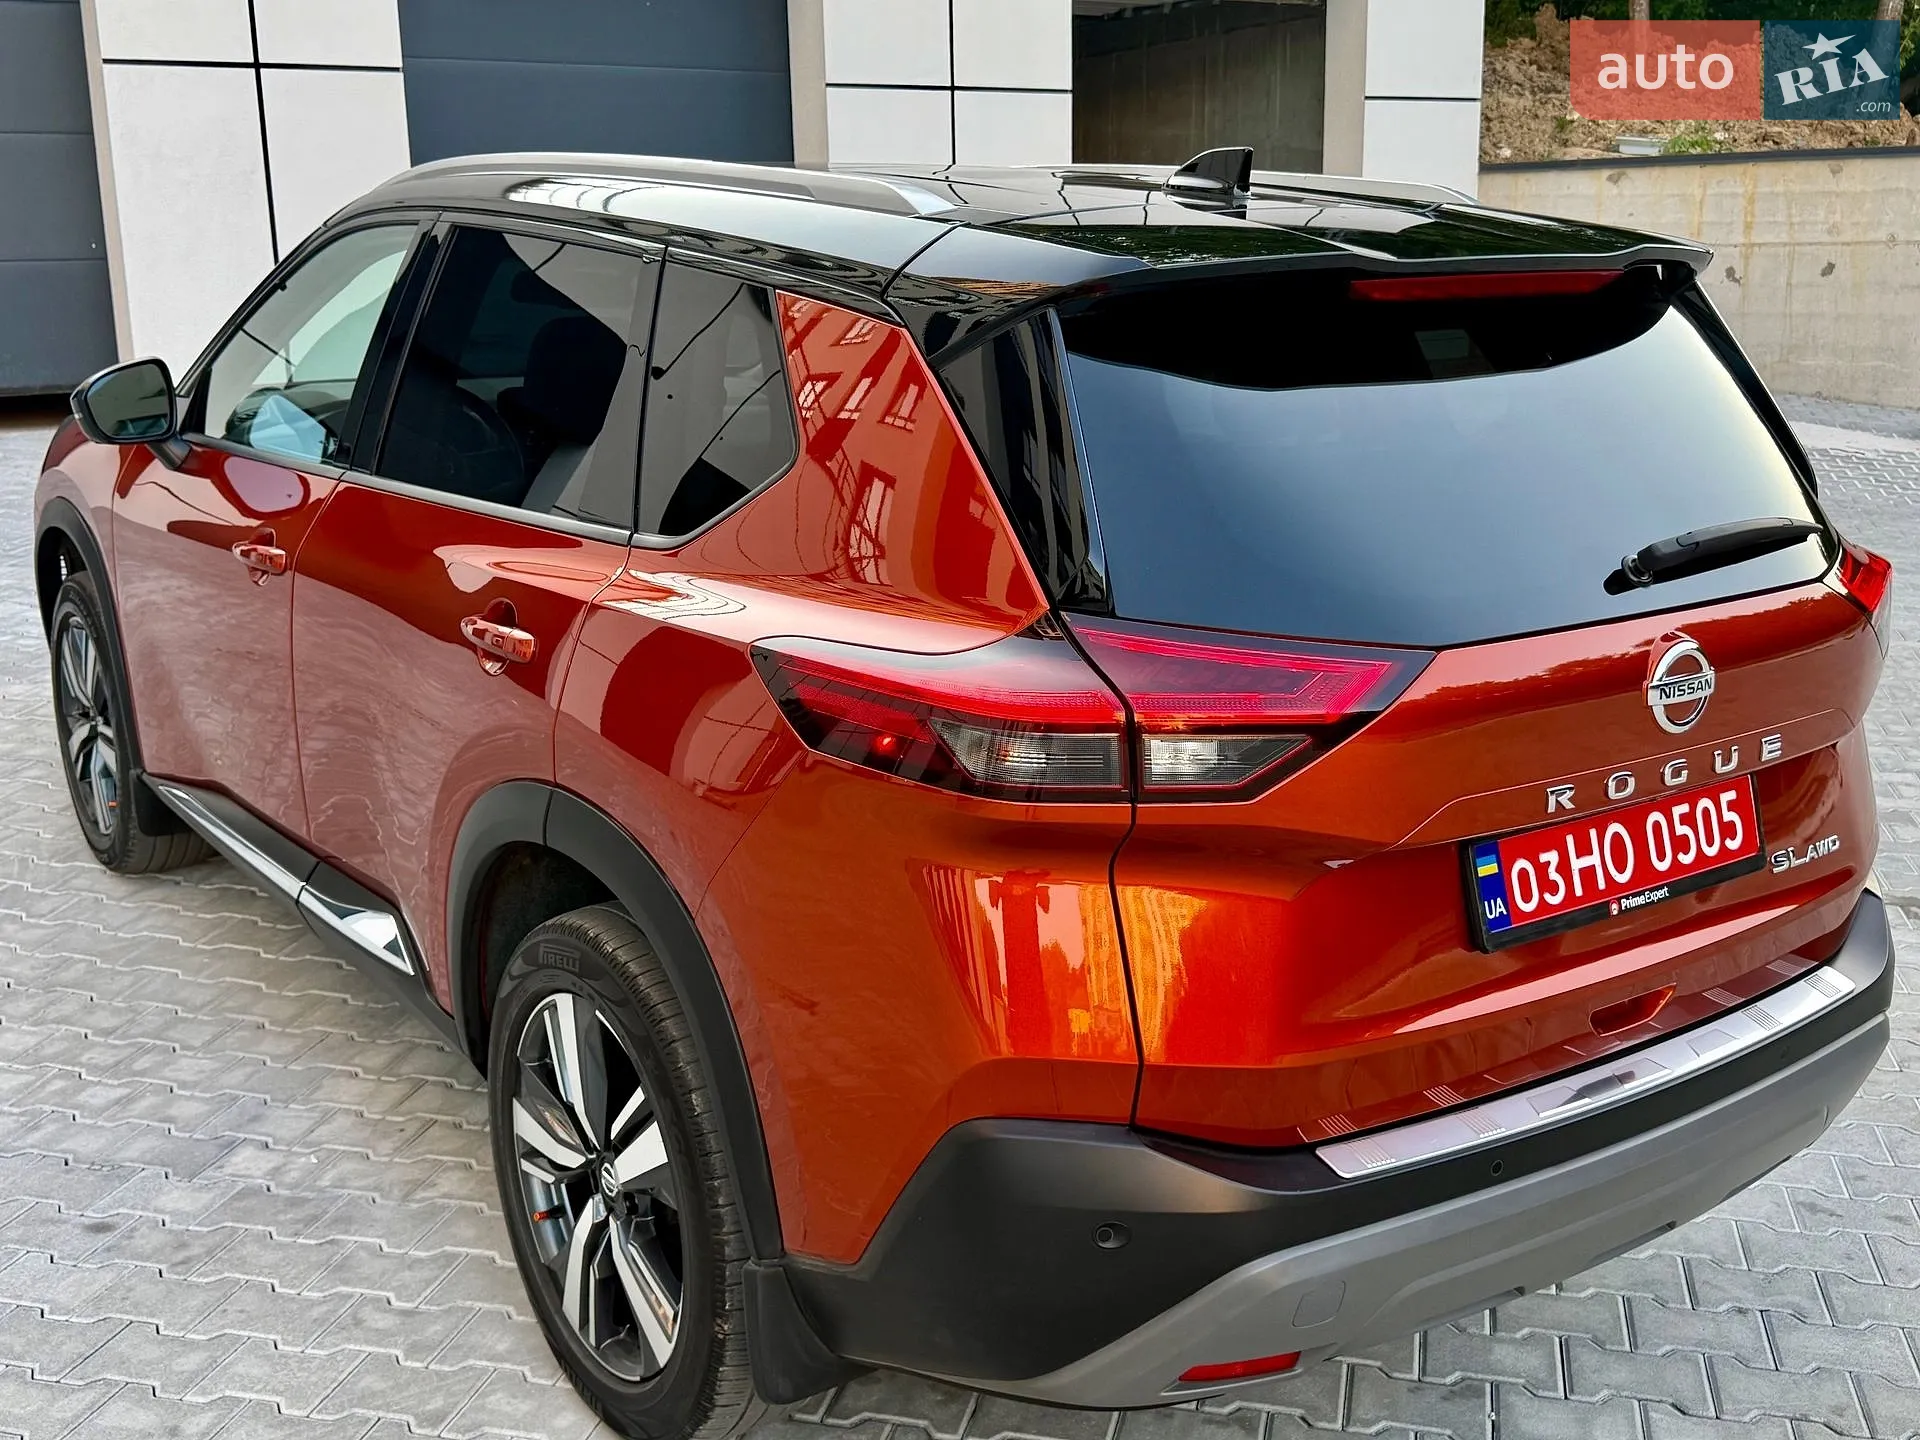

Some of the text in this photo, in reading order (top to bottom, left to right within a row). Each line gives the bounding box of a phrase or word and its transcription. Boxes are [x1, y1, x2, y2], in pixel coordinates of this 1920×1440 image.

[1659, 677, 1712, 700] NISSAN
[1545, 733, 1783, 814] ROGUE
[1510, 789, 1744, 913] 03HO 0505
[1484, 897, 1507, 919] UA
[538, 942, 581, 973] PIRELLI
